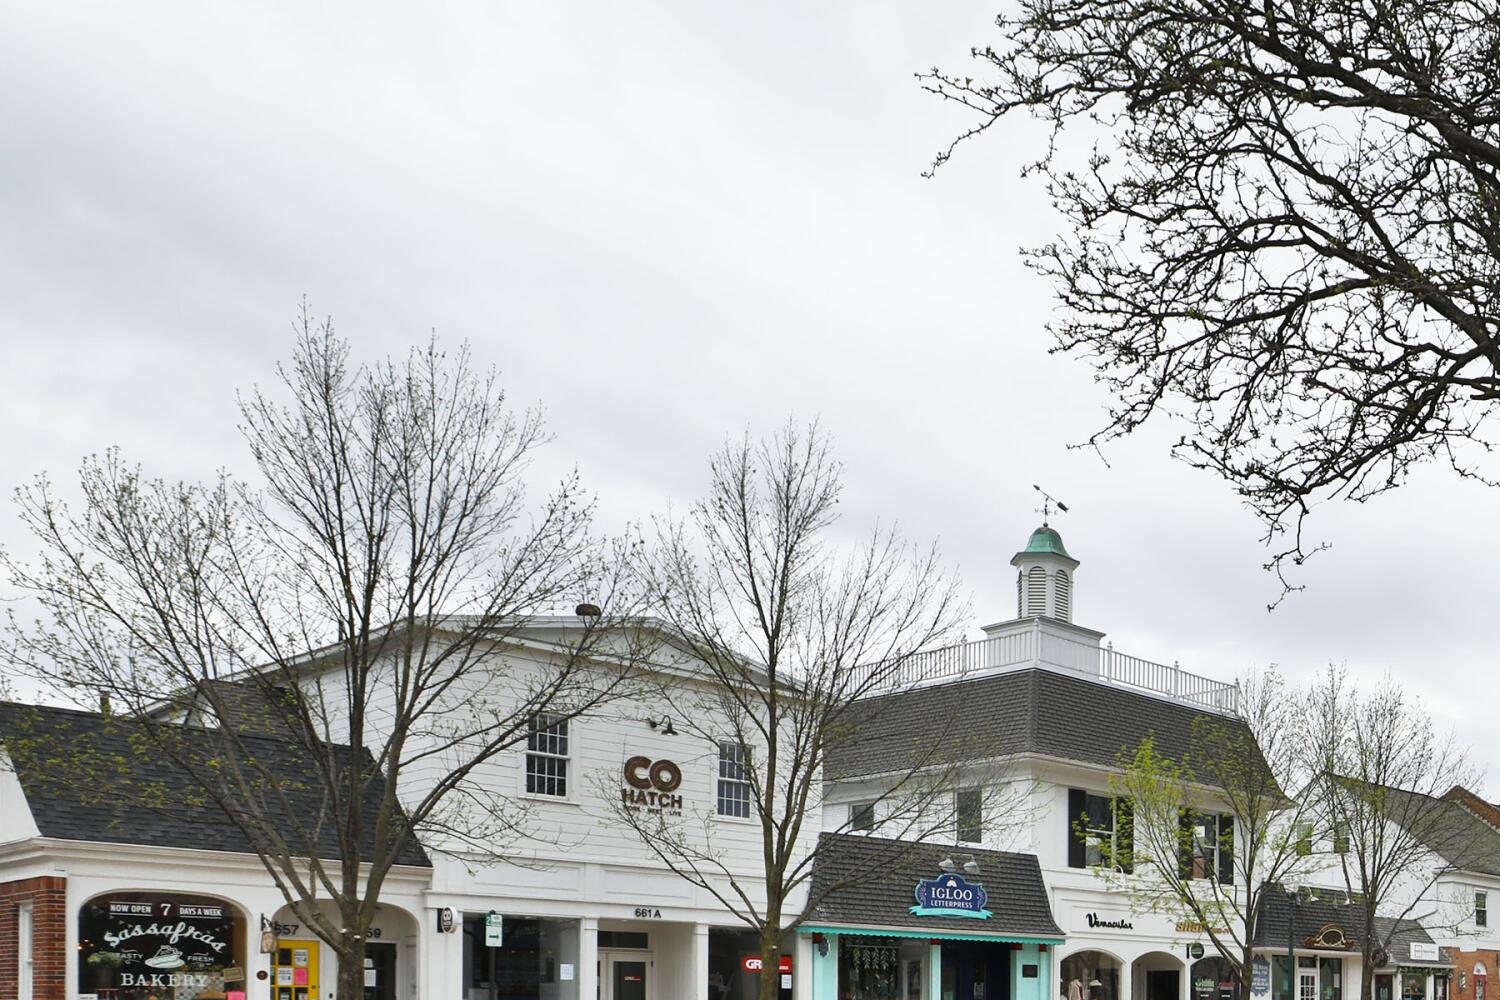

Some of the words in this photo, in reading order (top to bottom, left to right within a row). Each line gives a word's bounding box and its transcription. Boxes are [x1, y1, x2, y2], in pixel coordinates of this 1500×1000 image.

[624, 755, 682, 792] CO
[622, 788, 682, 809] HATCH
[931, 887, 972, 901] IGLOO
[110, 904, 130, 912] NOW
[131, 905, 152, 913] OPEN
[160, 903, 172, 916] 7
[931, 900, 973, 908] LETTERPRESS
[179, 907, 197, 915] DAYS
[203, 908, 222, 916] WEEK
[635, 908, 652, 918] 661
[653, 909, 662, 918] A
[1086, 912, 1133, 930] Vernacular
[103, 921, 227, 953] Sassafras
[187, 955, 215, 963] FRESH
[120, 973, 209, 987] BAKERY
